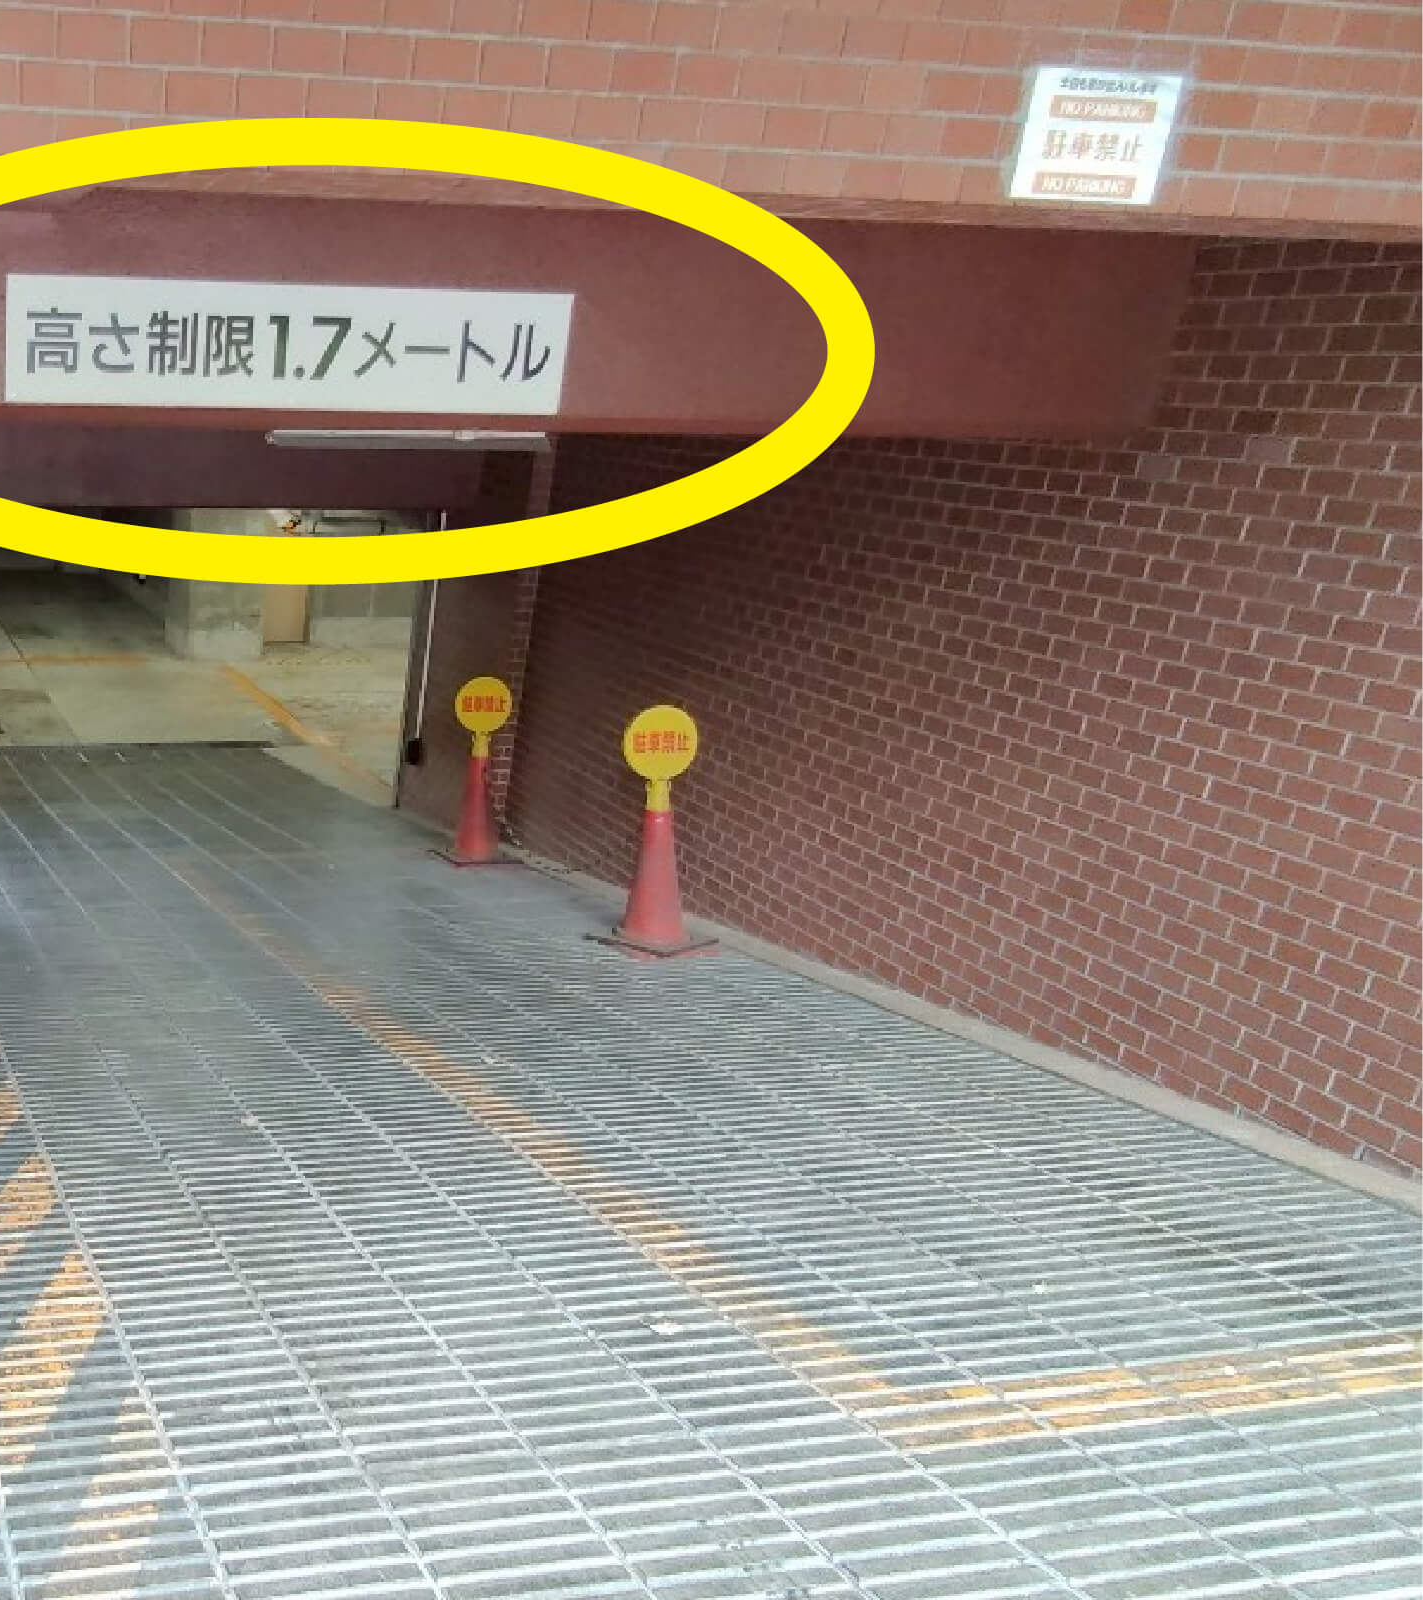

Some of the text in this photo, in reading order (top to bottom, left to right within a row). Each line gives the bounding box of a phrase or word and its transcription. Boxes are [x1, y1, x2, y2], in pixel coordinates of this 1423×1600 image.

[1060, 102, 1082, 115] NO
[1042, 130, 1145, 163] 駐車禁止
[1041, 177, 1064, 192] NO
[25, 307, 551, 384] 高さ制限1.7メートル
[632, 730, 691, 754] 駐車禁止
